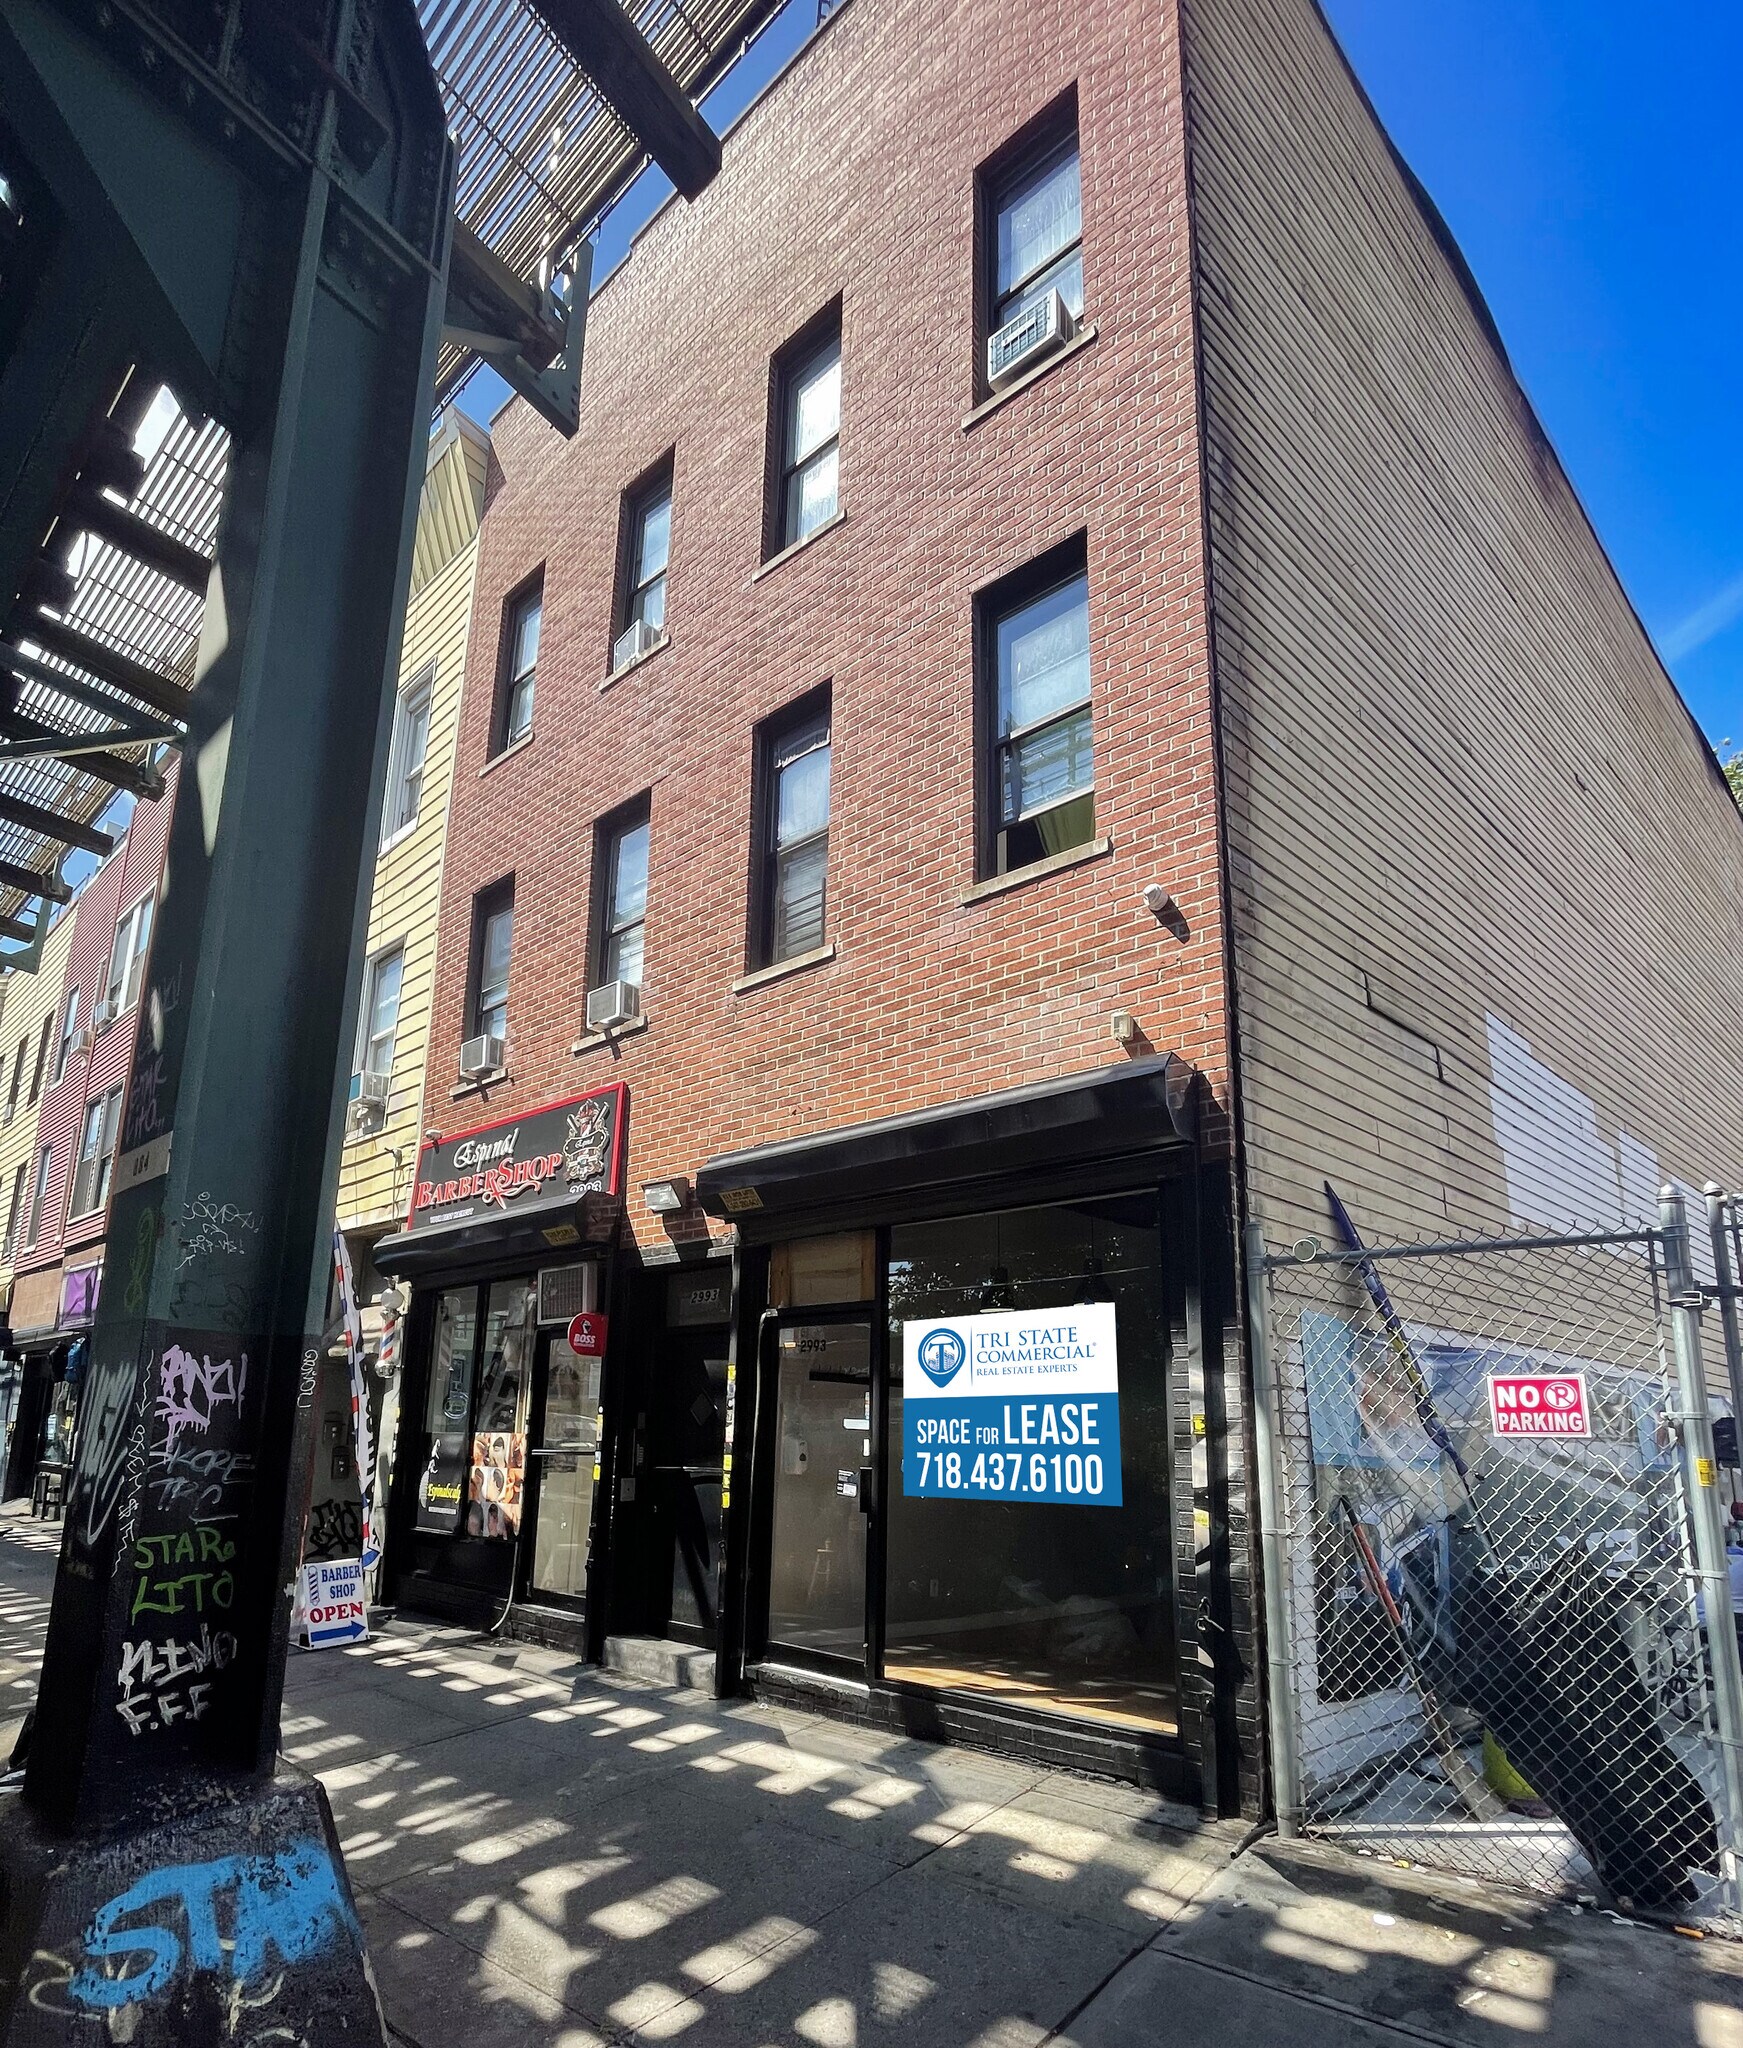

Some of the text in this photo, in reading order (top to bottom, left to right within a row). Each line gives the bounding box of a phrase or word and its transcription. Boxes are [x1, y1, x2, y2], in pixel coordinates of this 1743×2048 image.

[453, 1127, 520, 1172] Espinal
[691, 1289, 718, 1304] 2993
[574, 1333, 596, 1344] BOSS
[800, 1339, 827, 1352] 2993
[976, 1326, 1078, 1348] TRI STATE
[976, 1345, 1095, 1363] COMMERCIAL
[976, 1363, 1078, 1376] REAL ESTATE EXPERTS
[1496, 1385, 1540, 1408] NO
[917, 1403, 1100, 1445] SPACE FOR LEASE
[1497, 1412, 1583, 1431] PARKING
[916, 1451, 1104, 1495] 718.437.6100
[321, 1565, 361, 1583] BARBER
[329, 1583, 356, 1599] SHOP
[309, 1601, 364, 1624] OPEN
